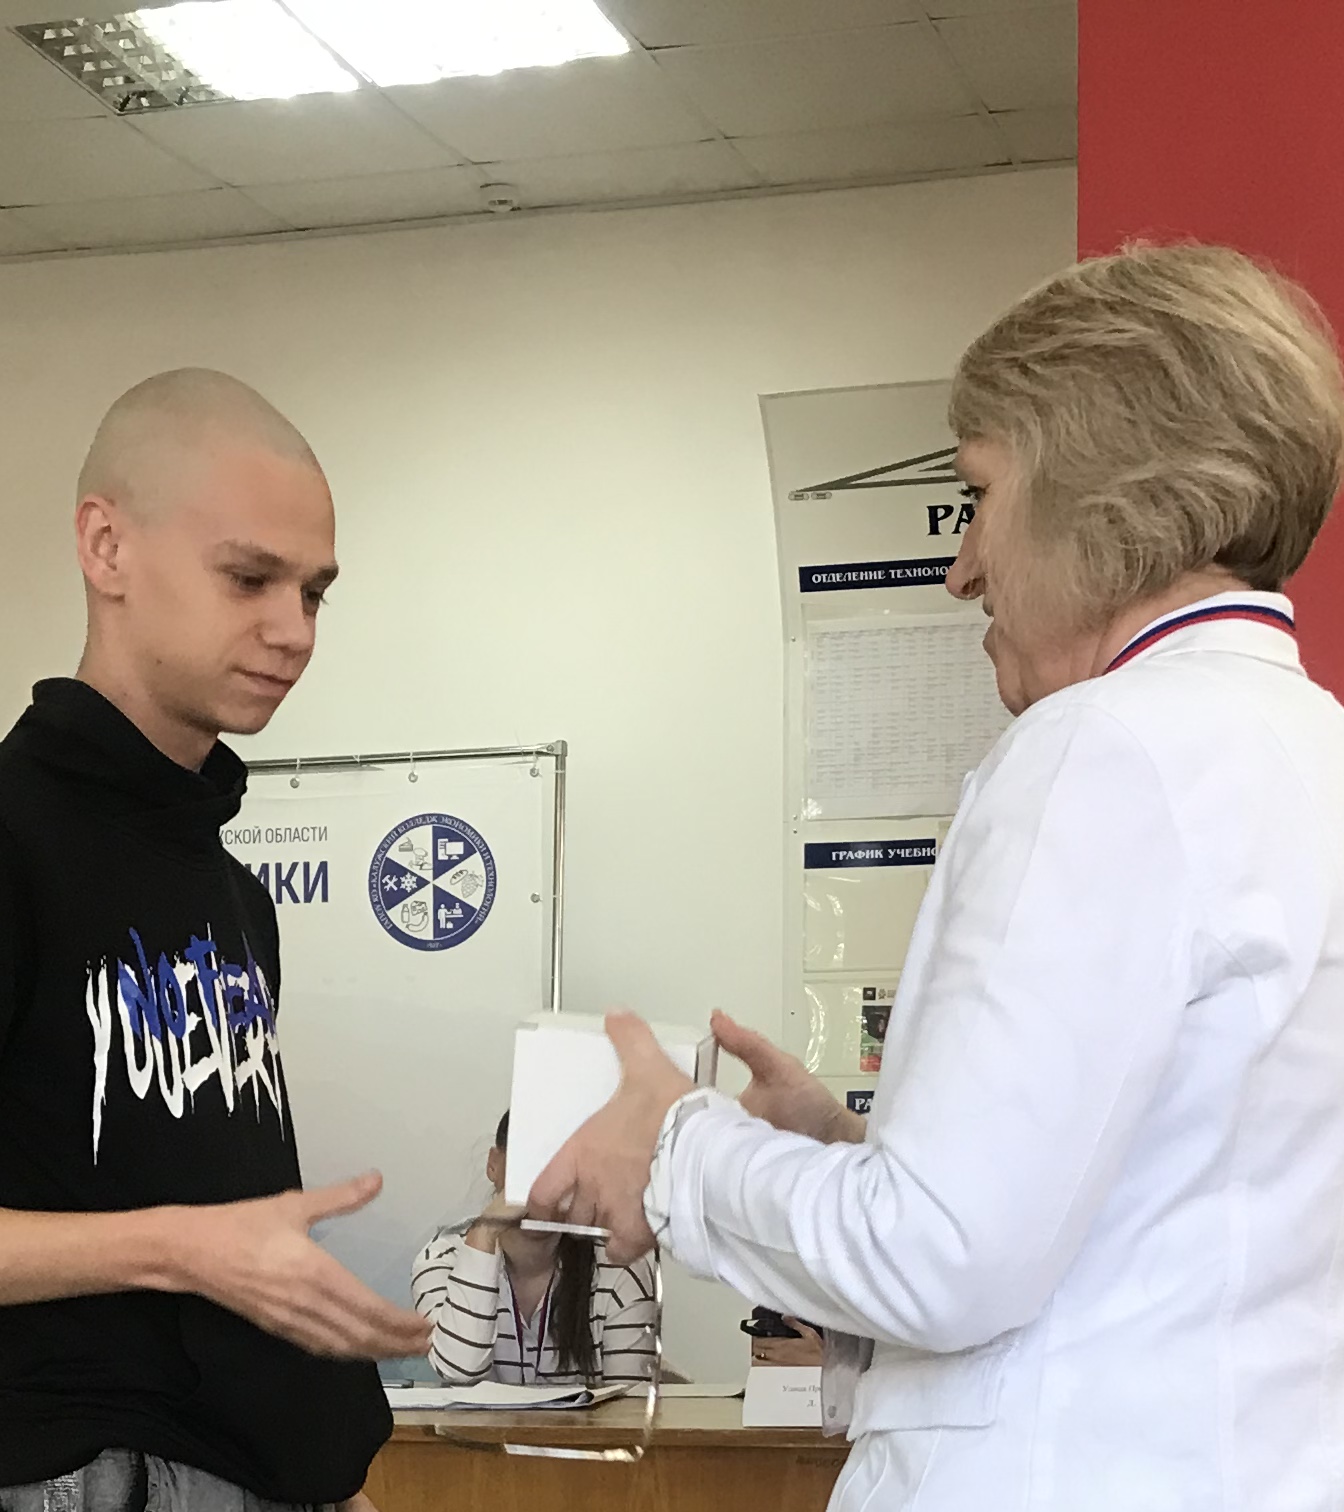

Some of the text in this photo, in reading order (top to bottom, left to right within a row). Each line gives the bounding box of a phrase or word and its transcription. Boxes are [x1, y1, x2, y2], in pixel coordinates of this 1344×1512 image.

[811, 564, 955, 584] ОТДЕЛЕНИЕ ТЕХНОЛО
[265, 825, 328, 844] ОБЛАСТИ
[831, 849, 884, 861] ГРАФИК
